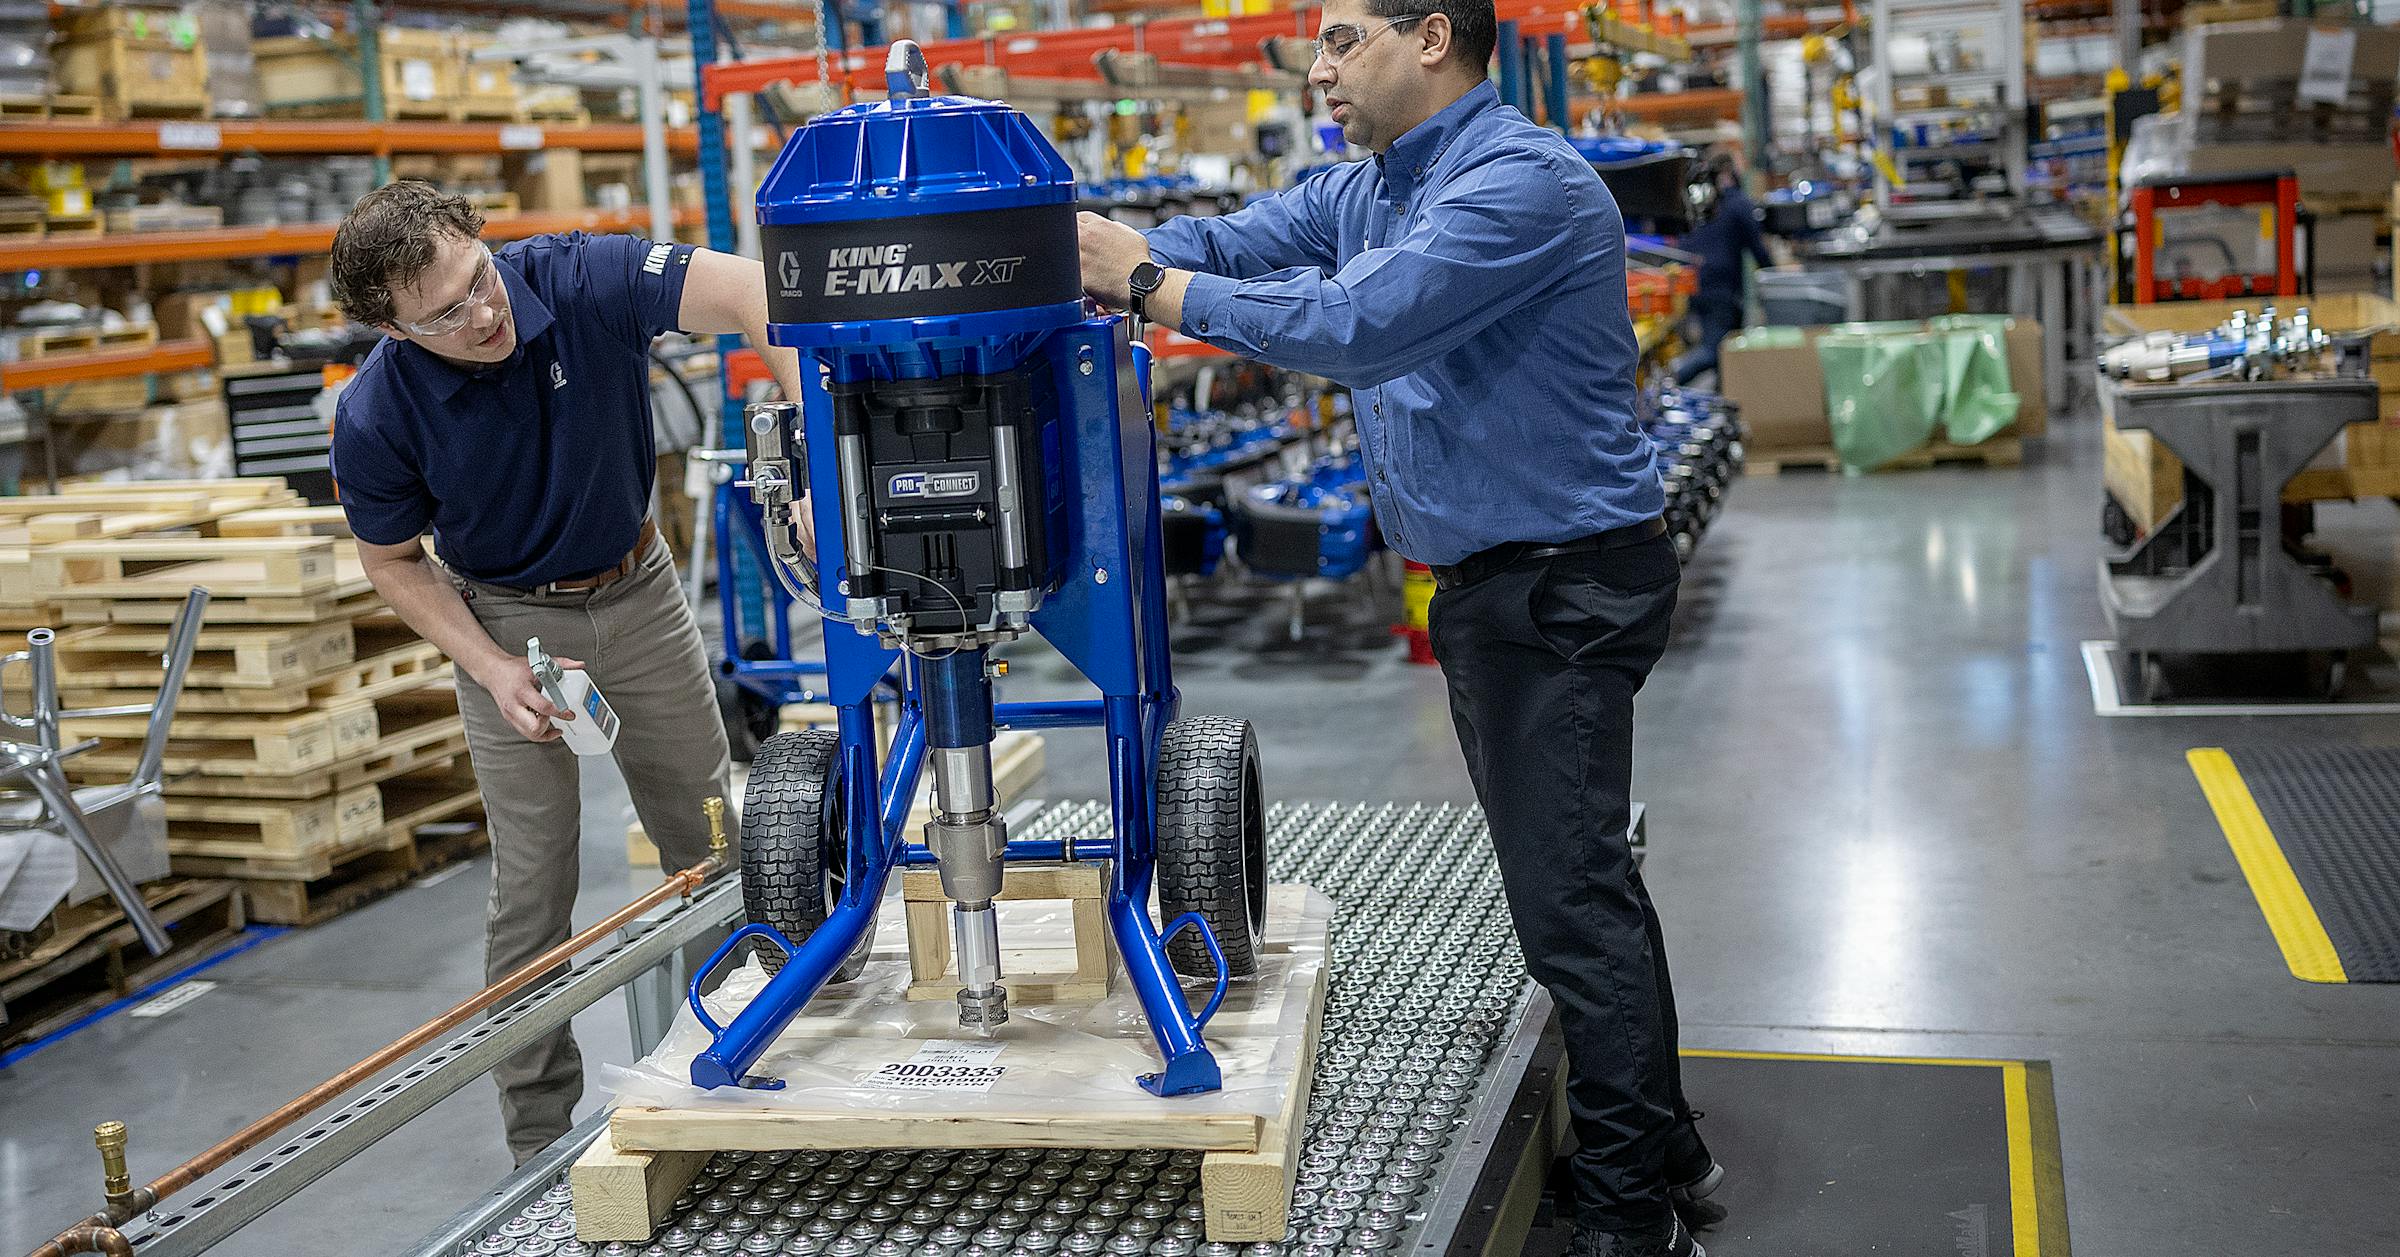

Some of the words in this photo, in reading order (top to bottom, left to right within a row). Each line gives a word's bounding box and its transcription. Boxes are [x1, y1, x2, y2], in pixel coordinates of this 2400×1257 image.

[828, 243, 908, 268] KING
[823, 261, 968, 296] E-MAX
[970, 257, 1023, 285] XT
[896, 479, 915, 491] PRO
[933, 478, 973, 492] CONNECT
[878, 1064, 1006, 1077] 2003333
